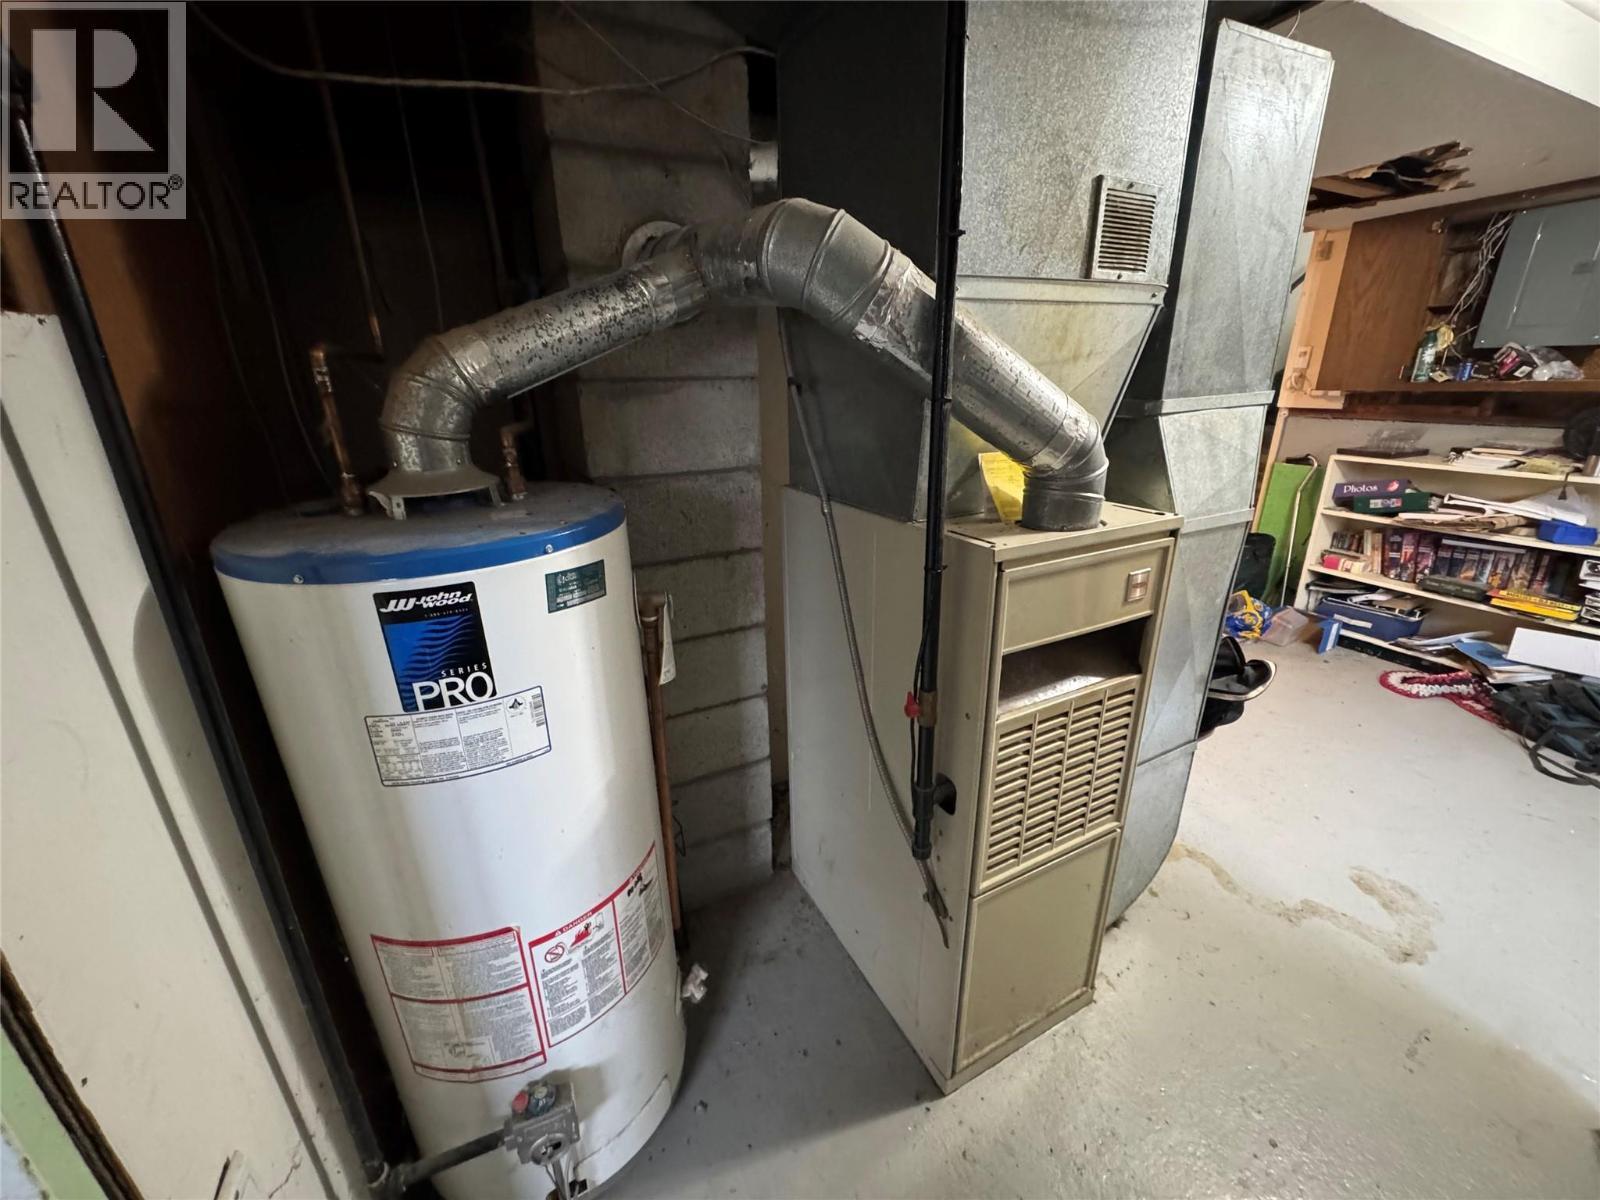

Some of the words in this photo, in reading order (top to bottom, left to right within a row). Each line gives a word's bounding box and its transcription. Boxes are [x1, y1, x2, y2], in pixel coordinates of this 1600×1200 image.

[1343, 484, 1378, 494] Photos
[422, 593, 473, 608] wood
[441, 662, 487, 677] SERIES
[412, 671, 494, 712] PRO
[562, 911, 593, 932] DANGER
